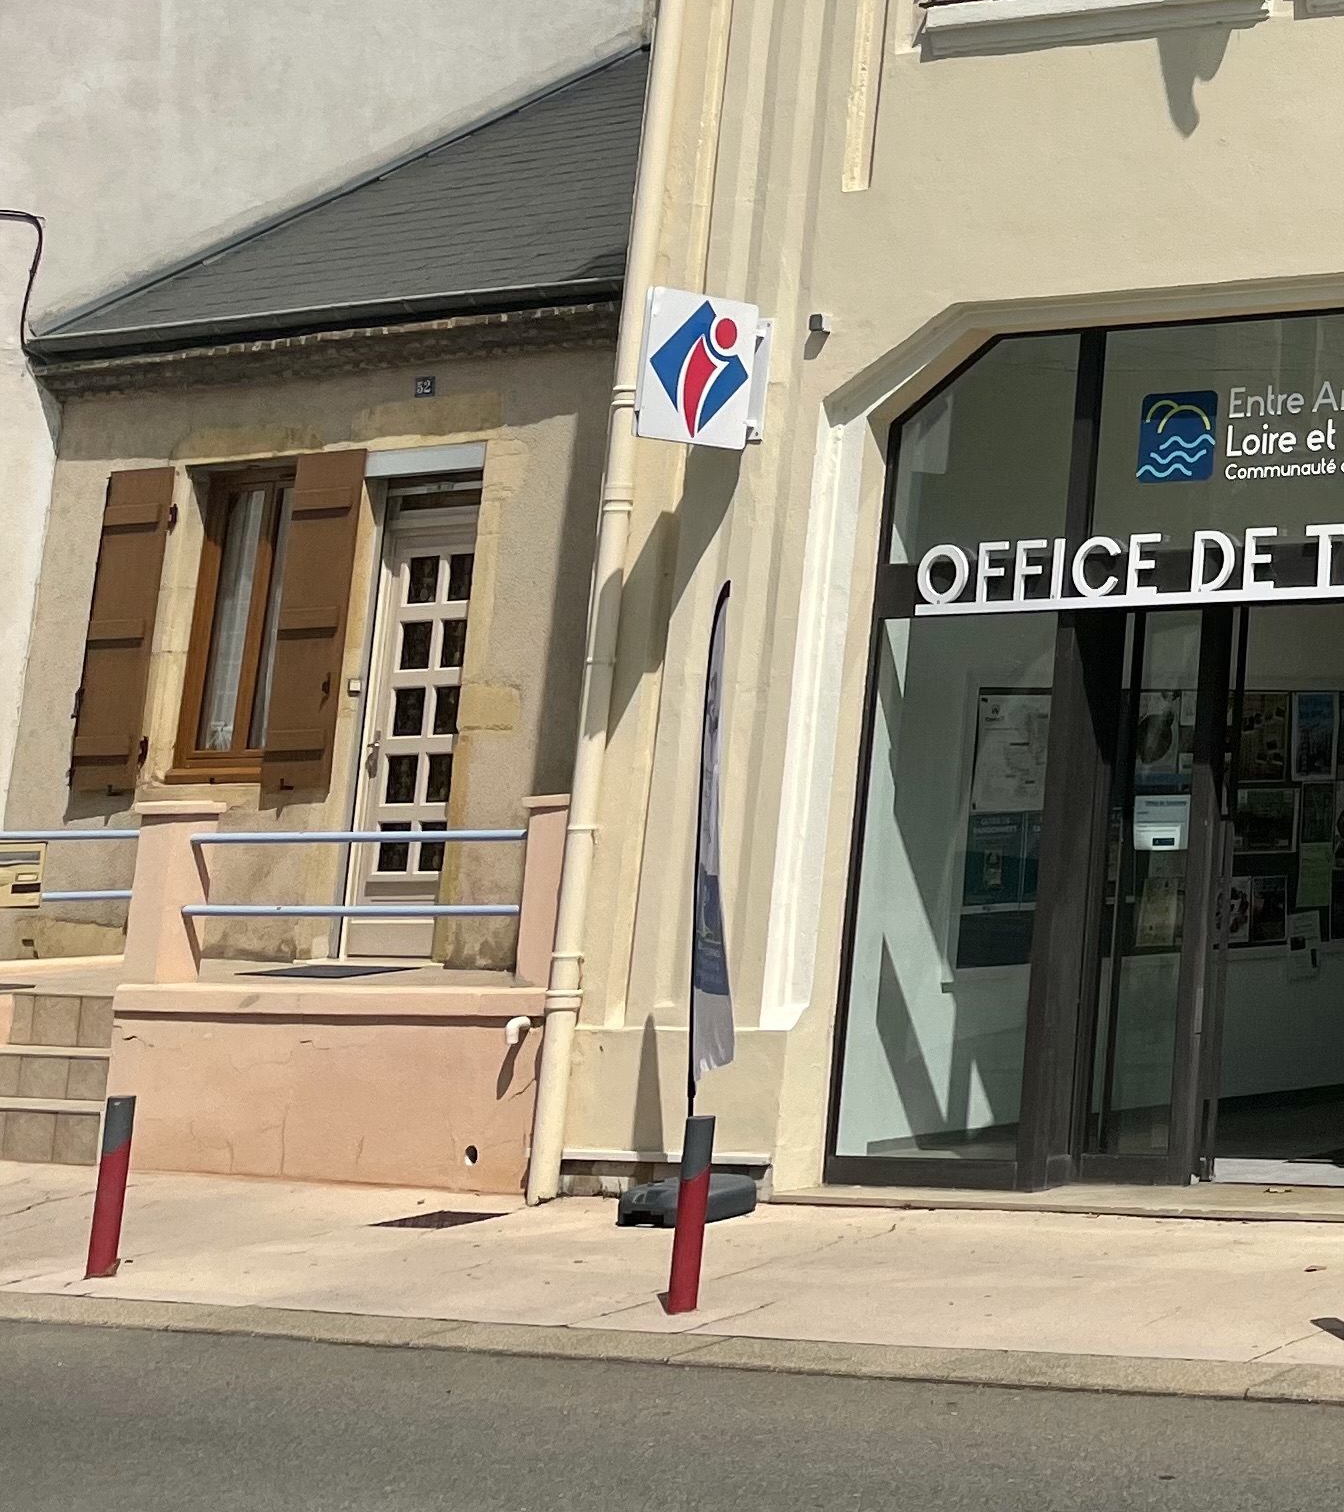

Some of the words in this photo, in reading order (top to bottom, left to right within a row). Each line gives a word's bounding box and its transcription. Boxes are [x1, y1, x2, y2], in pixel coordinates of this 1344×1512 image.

[416, 379, 431, 394] 52
[1229, 386, 1304, 418] Entre
[1226, 423, 1297, 457] Loire
[1306, 418, 1336, 452] et
[1225, 457, 1337, 481] Communauté
[917, 533, 1161, 605] OFFICE
[1190, 527, 1277, 593] DE
